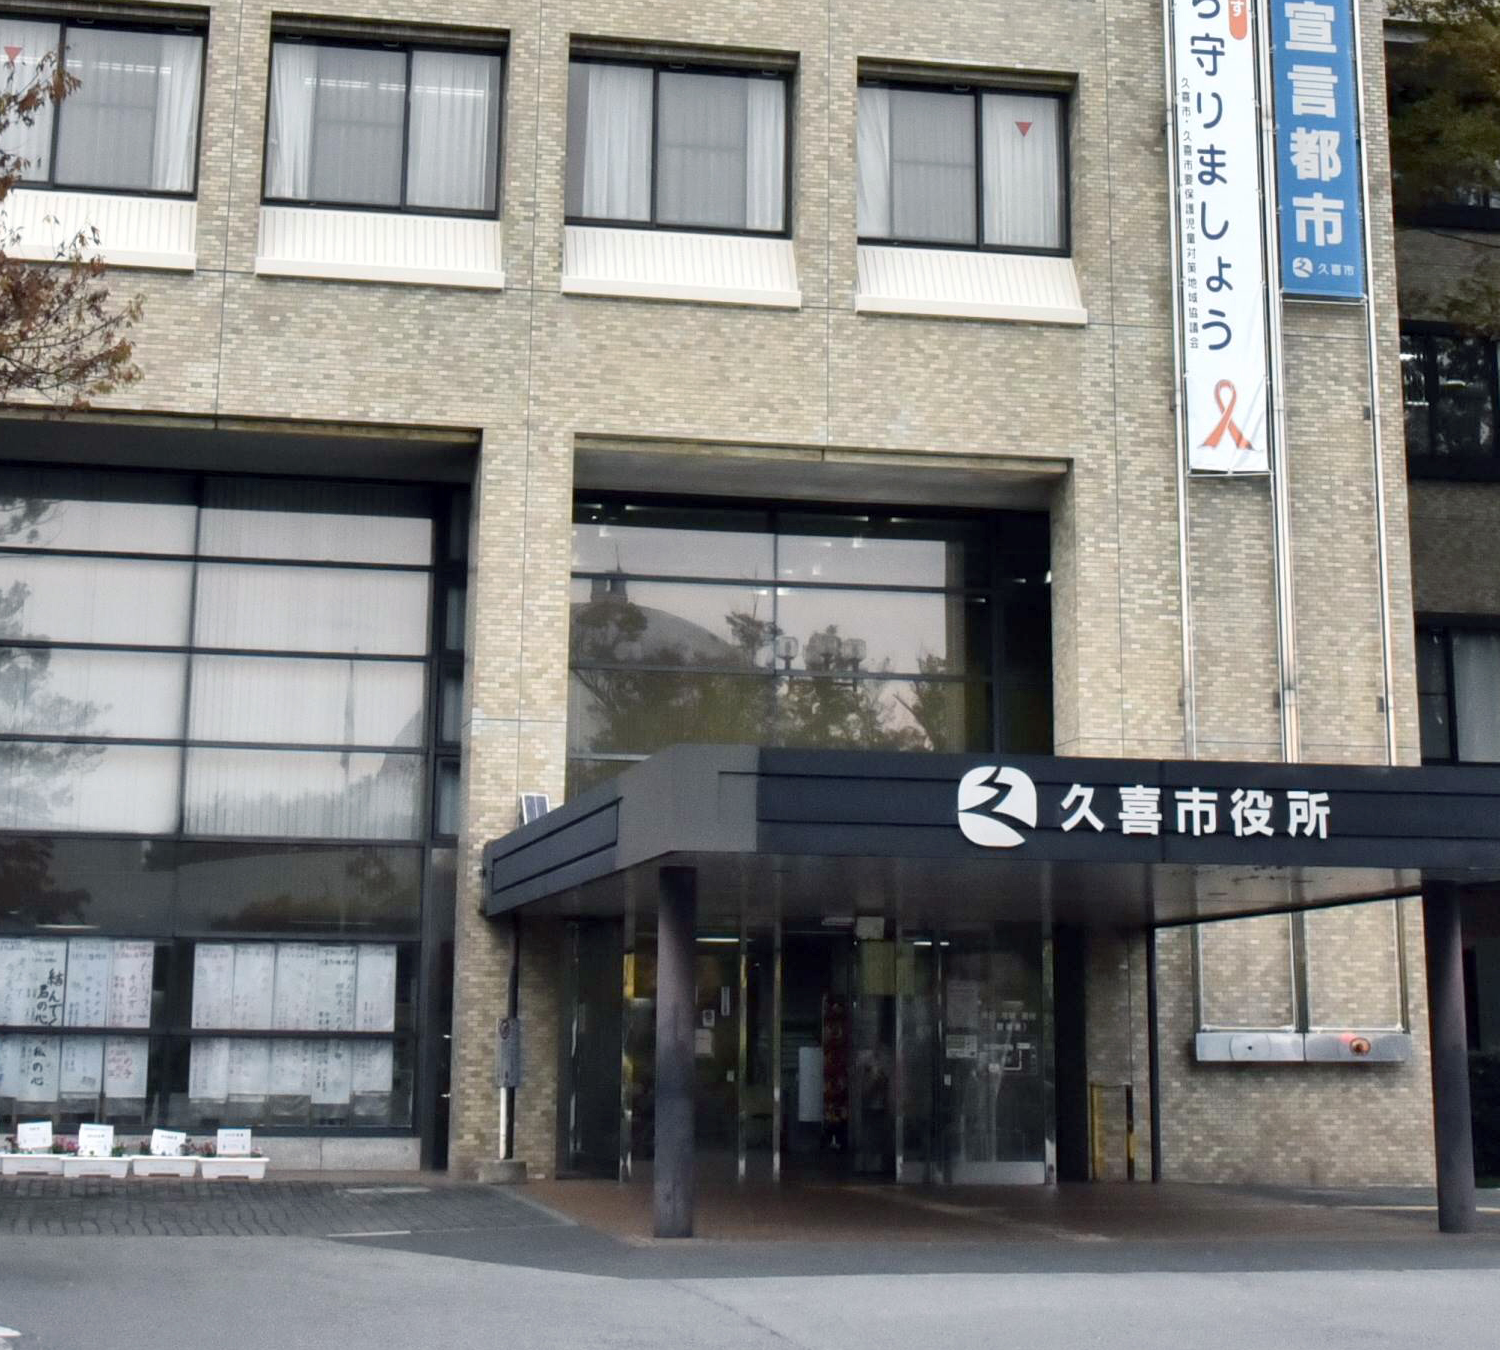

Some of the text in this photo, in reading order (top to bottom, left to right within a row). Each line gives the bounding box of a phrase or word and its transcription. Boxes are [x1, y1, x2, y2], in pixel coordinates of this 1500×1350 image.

[1318, 262, 1355, 276] 久喜市
[1060, 784, 1331, 839] 久喜市役所
